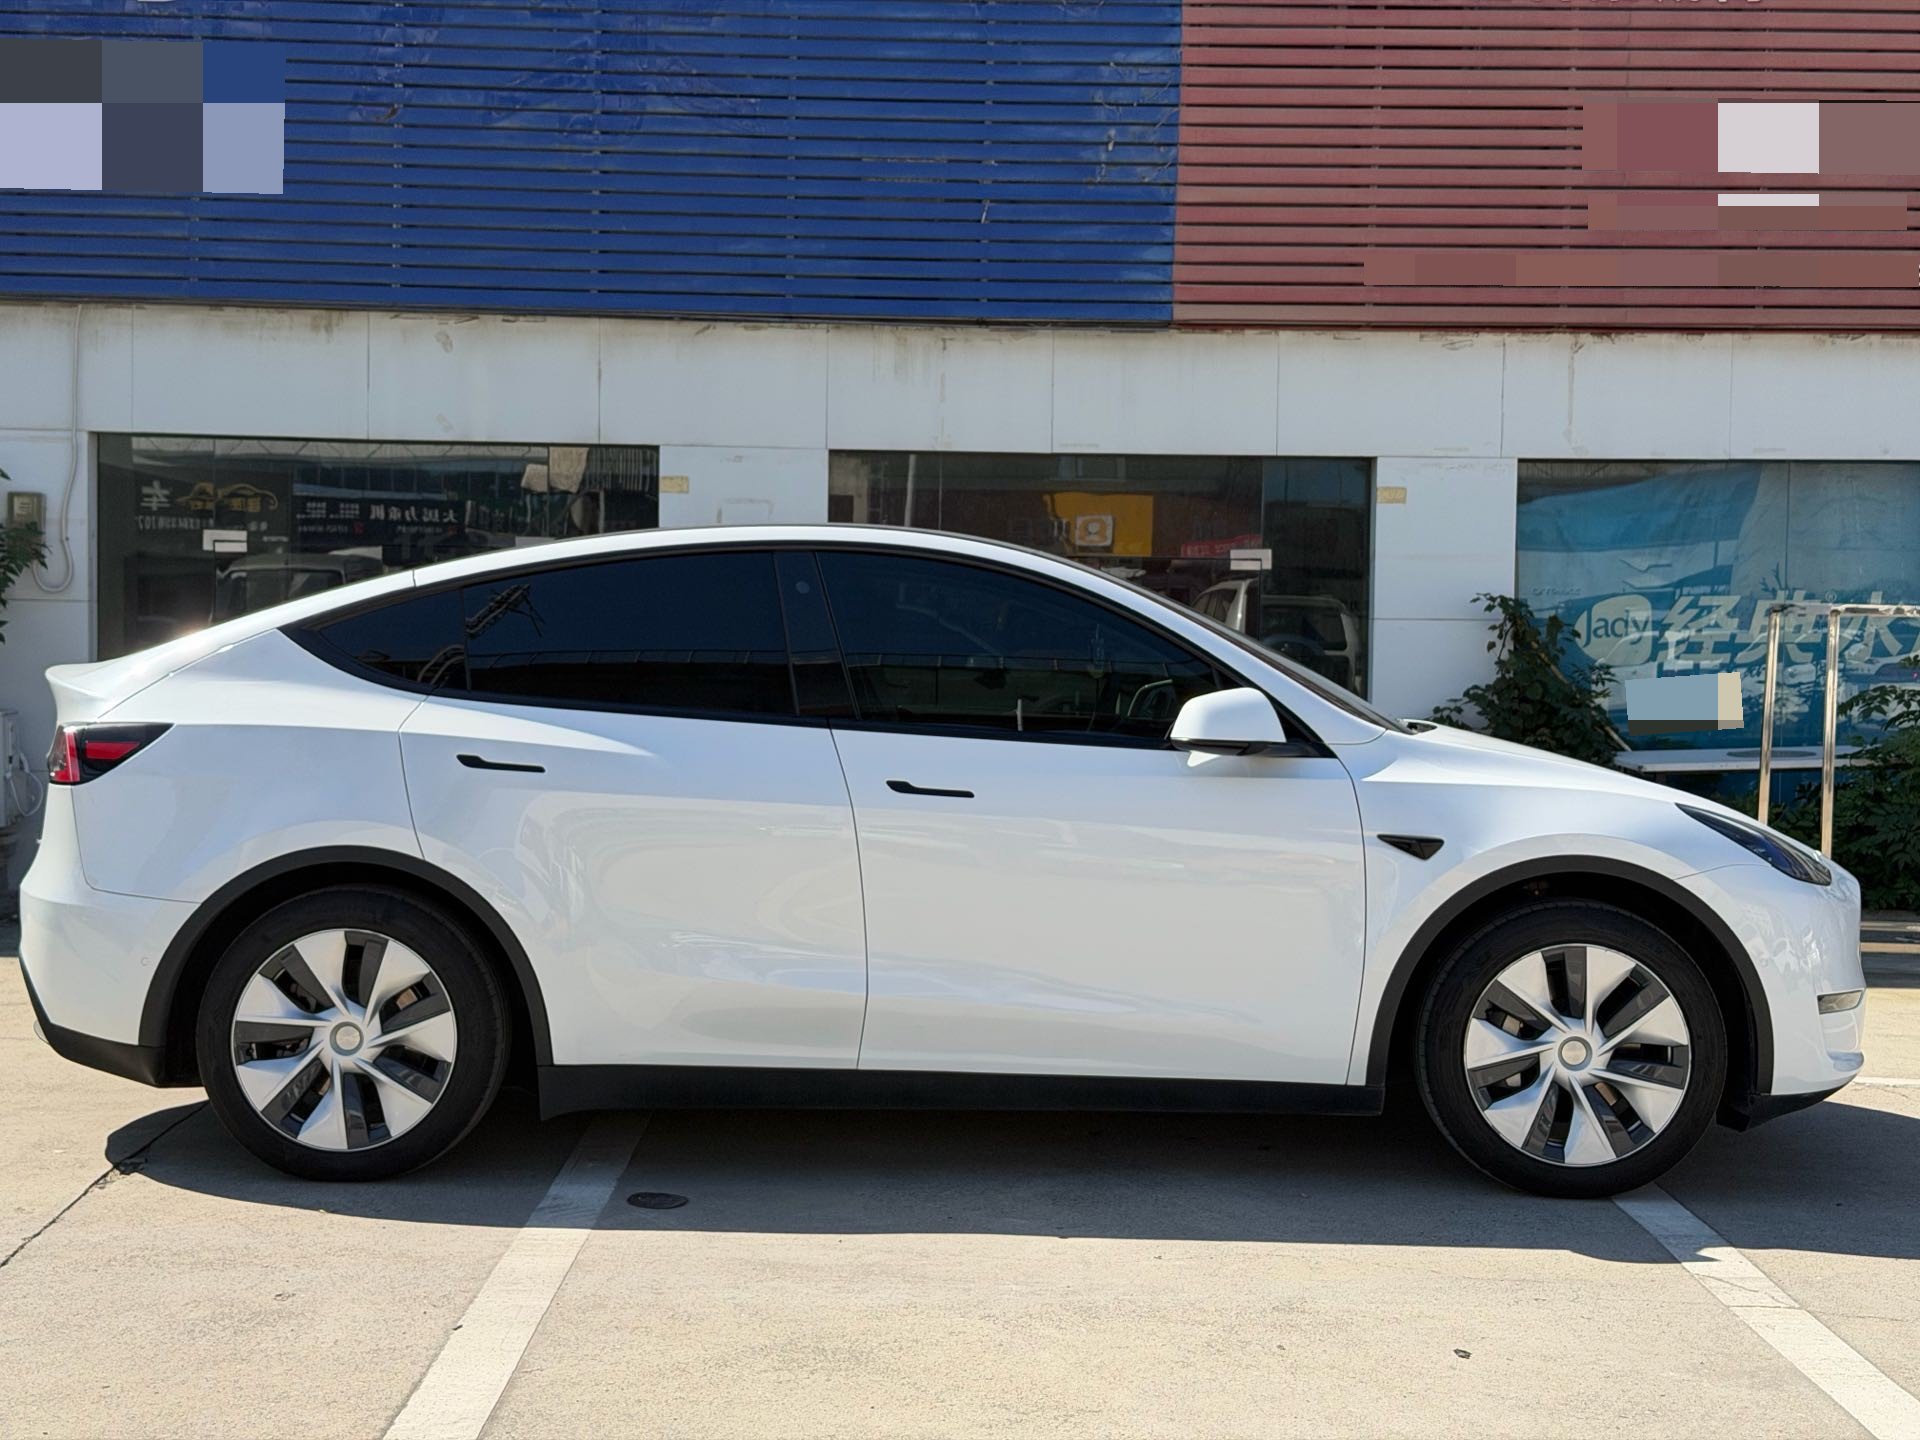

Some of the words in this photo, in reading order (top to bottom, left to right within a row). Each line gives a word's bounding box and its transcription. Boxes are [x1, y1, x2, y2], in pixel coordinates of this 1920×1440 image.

[1583, 608, 1649, 646] Jady
[1655, 590, 1920, 667] 经典水
